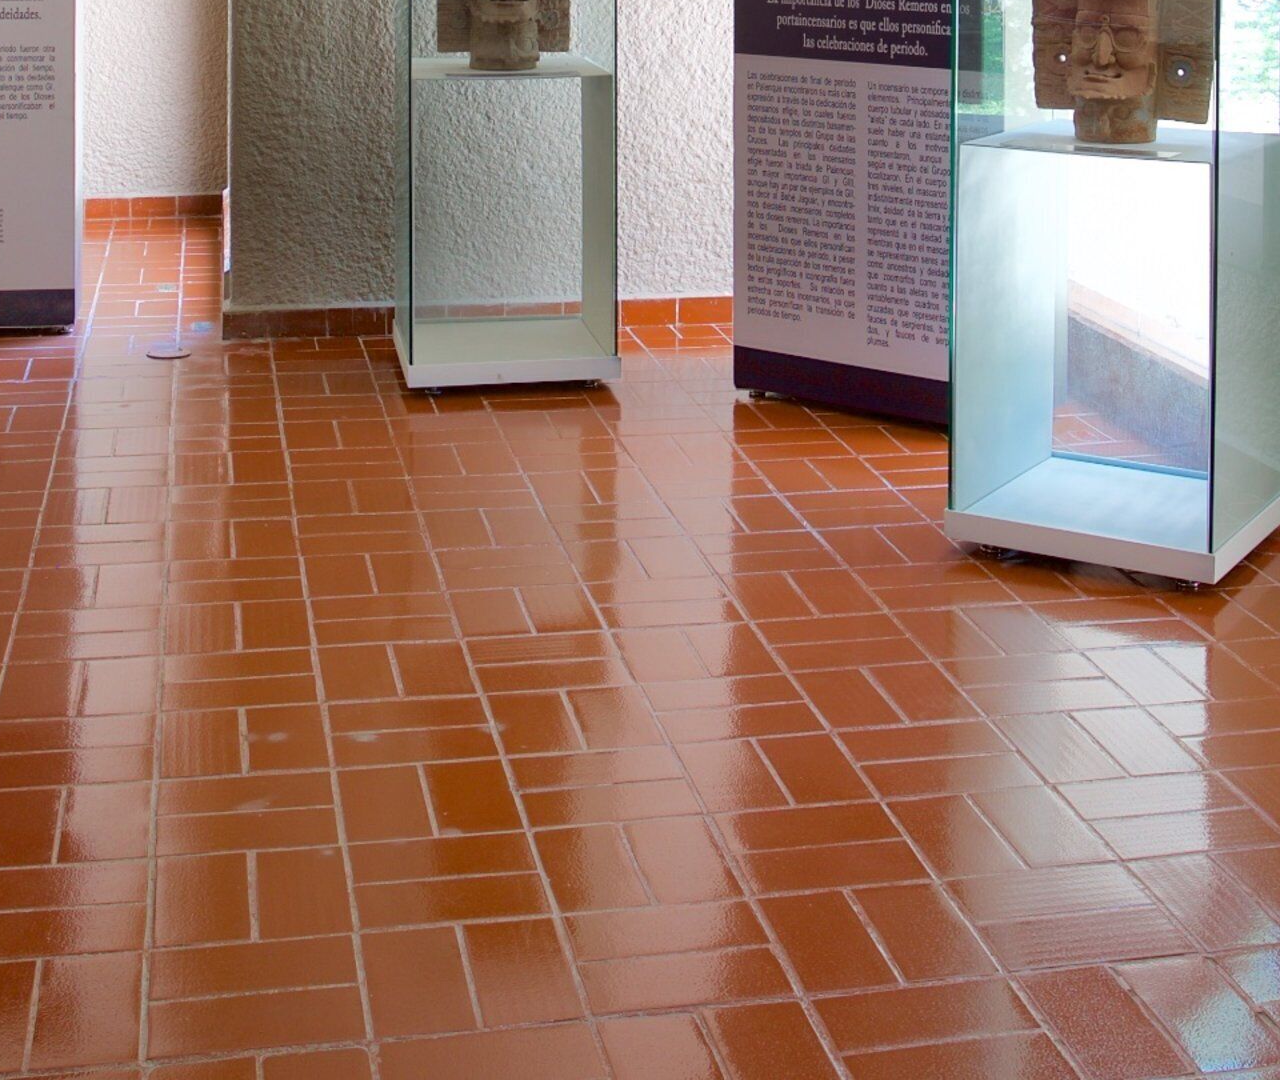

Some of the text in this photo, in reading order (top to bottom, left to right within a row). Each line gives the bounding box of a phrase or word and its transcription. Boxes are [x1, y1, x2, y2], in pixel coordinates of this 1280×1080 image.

[0, 7, 41, 20] deidades.
[940, 3, 952, 13] en
[776, 12, 952, 38] portaincensarios es que ellos personifica
[803, 34, 928, 59] las celebraciones de periodo.
